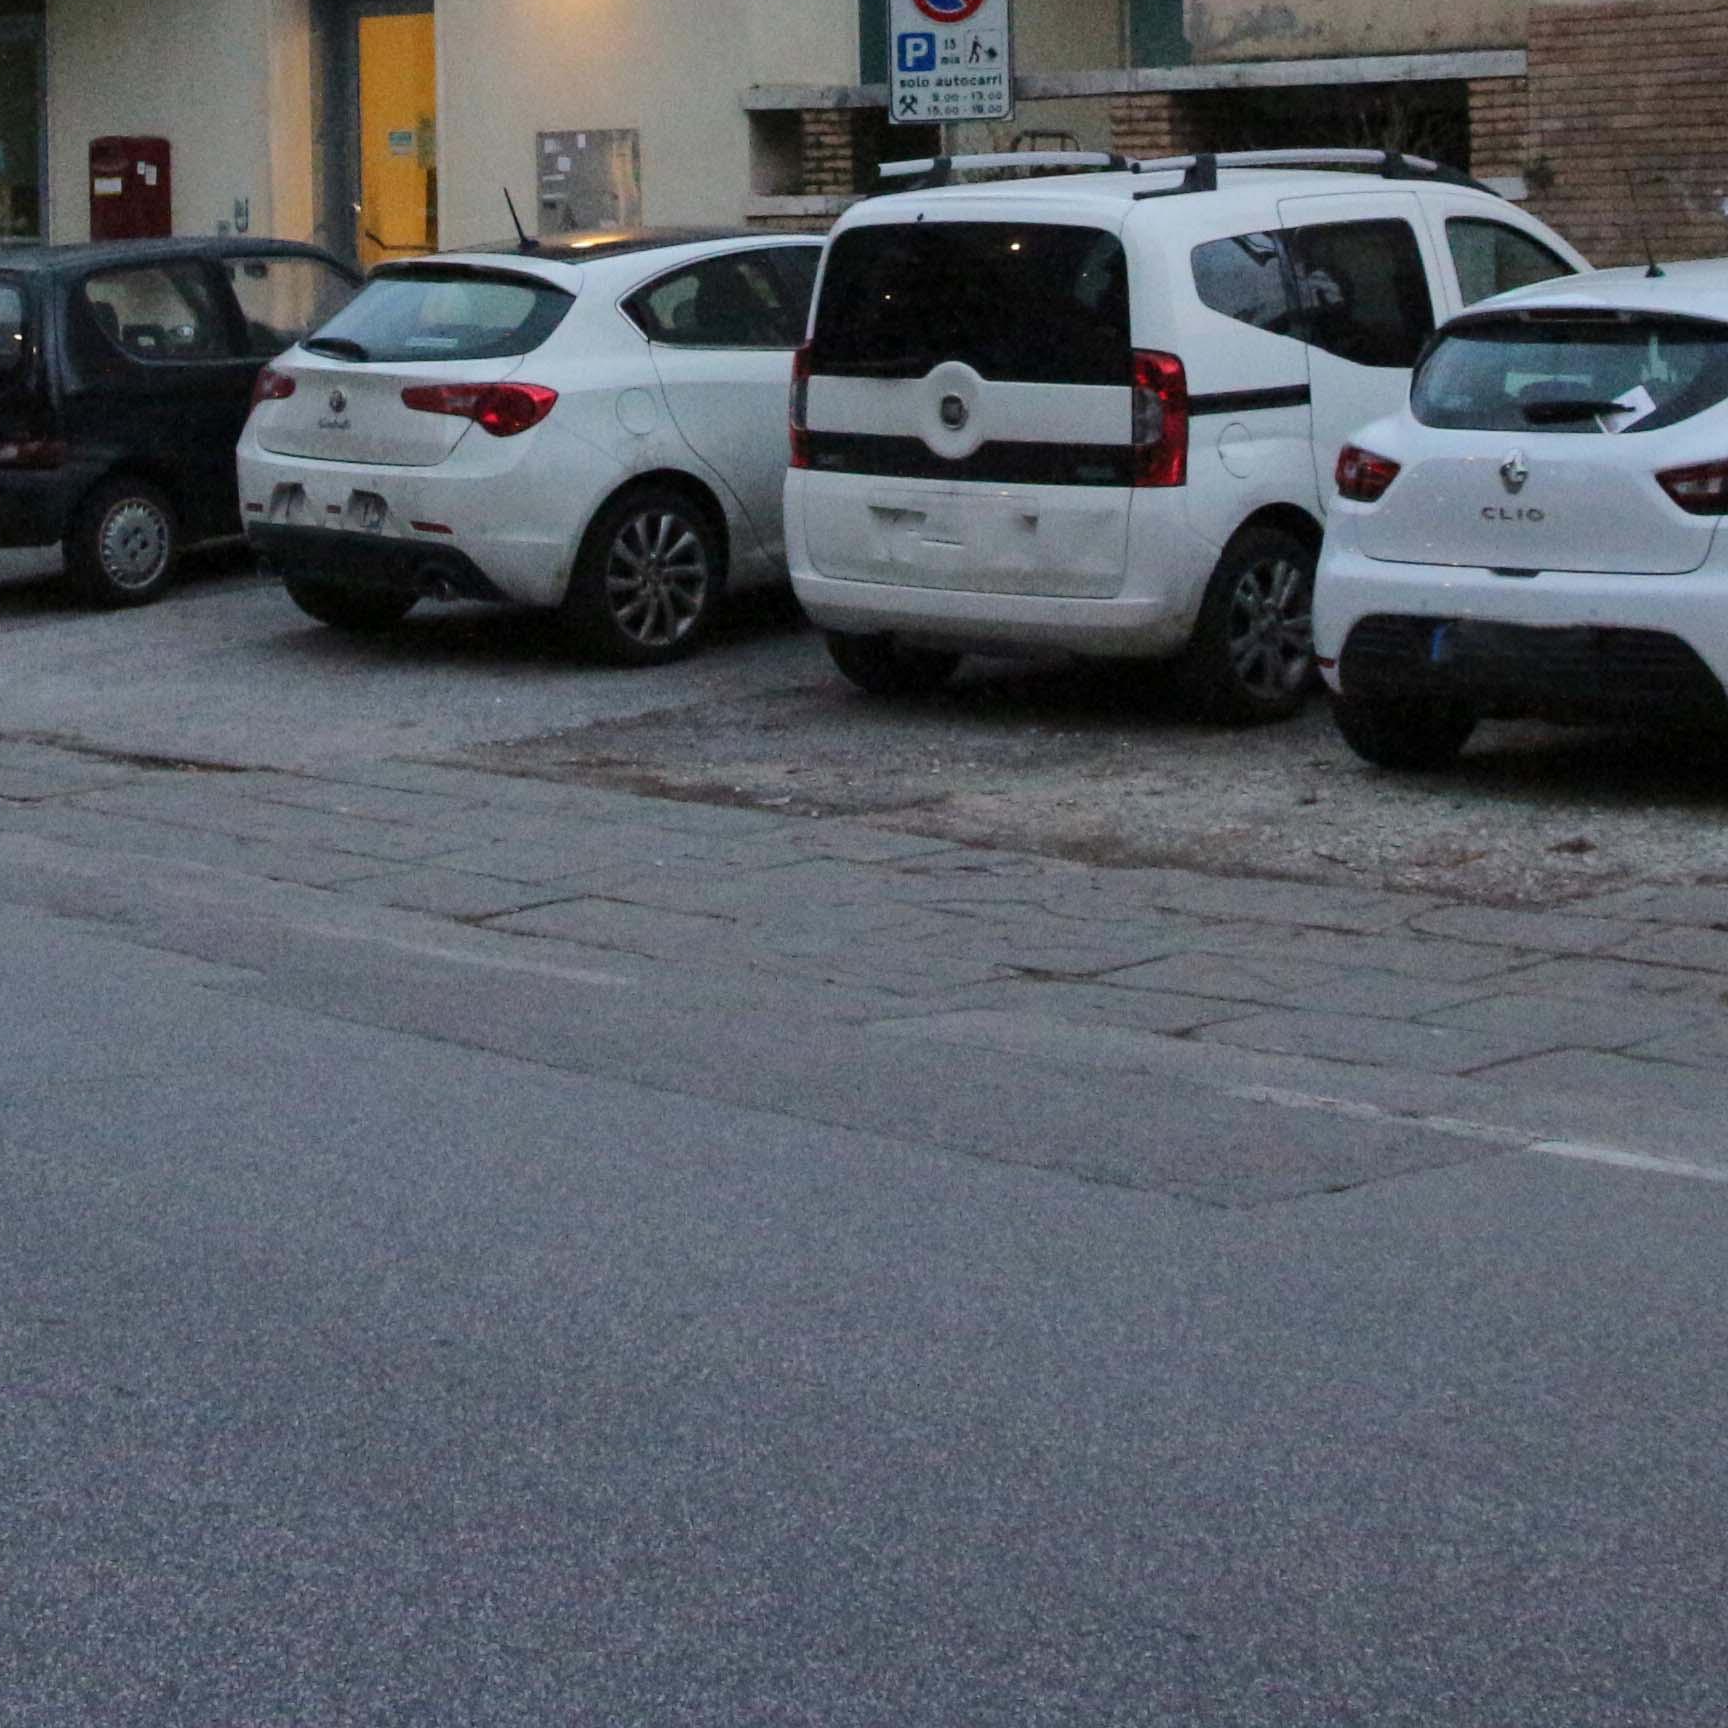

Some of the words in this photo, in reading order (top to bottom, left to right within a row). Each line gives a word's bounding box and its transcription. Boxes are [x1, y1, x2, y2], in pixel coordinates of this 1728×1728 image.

[905, 37, 928, 68] P
[899, 75, 930, 88] solo
[935, 73, 1003, 87] autocarri
[1480, 506, 1545, 522] CLIO
